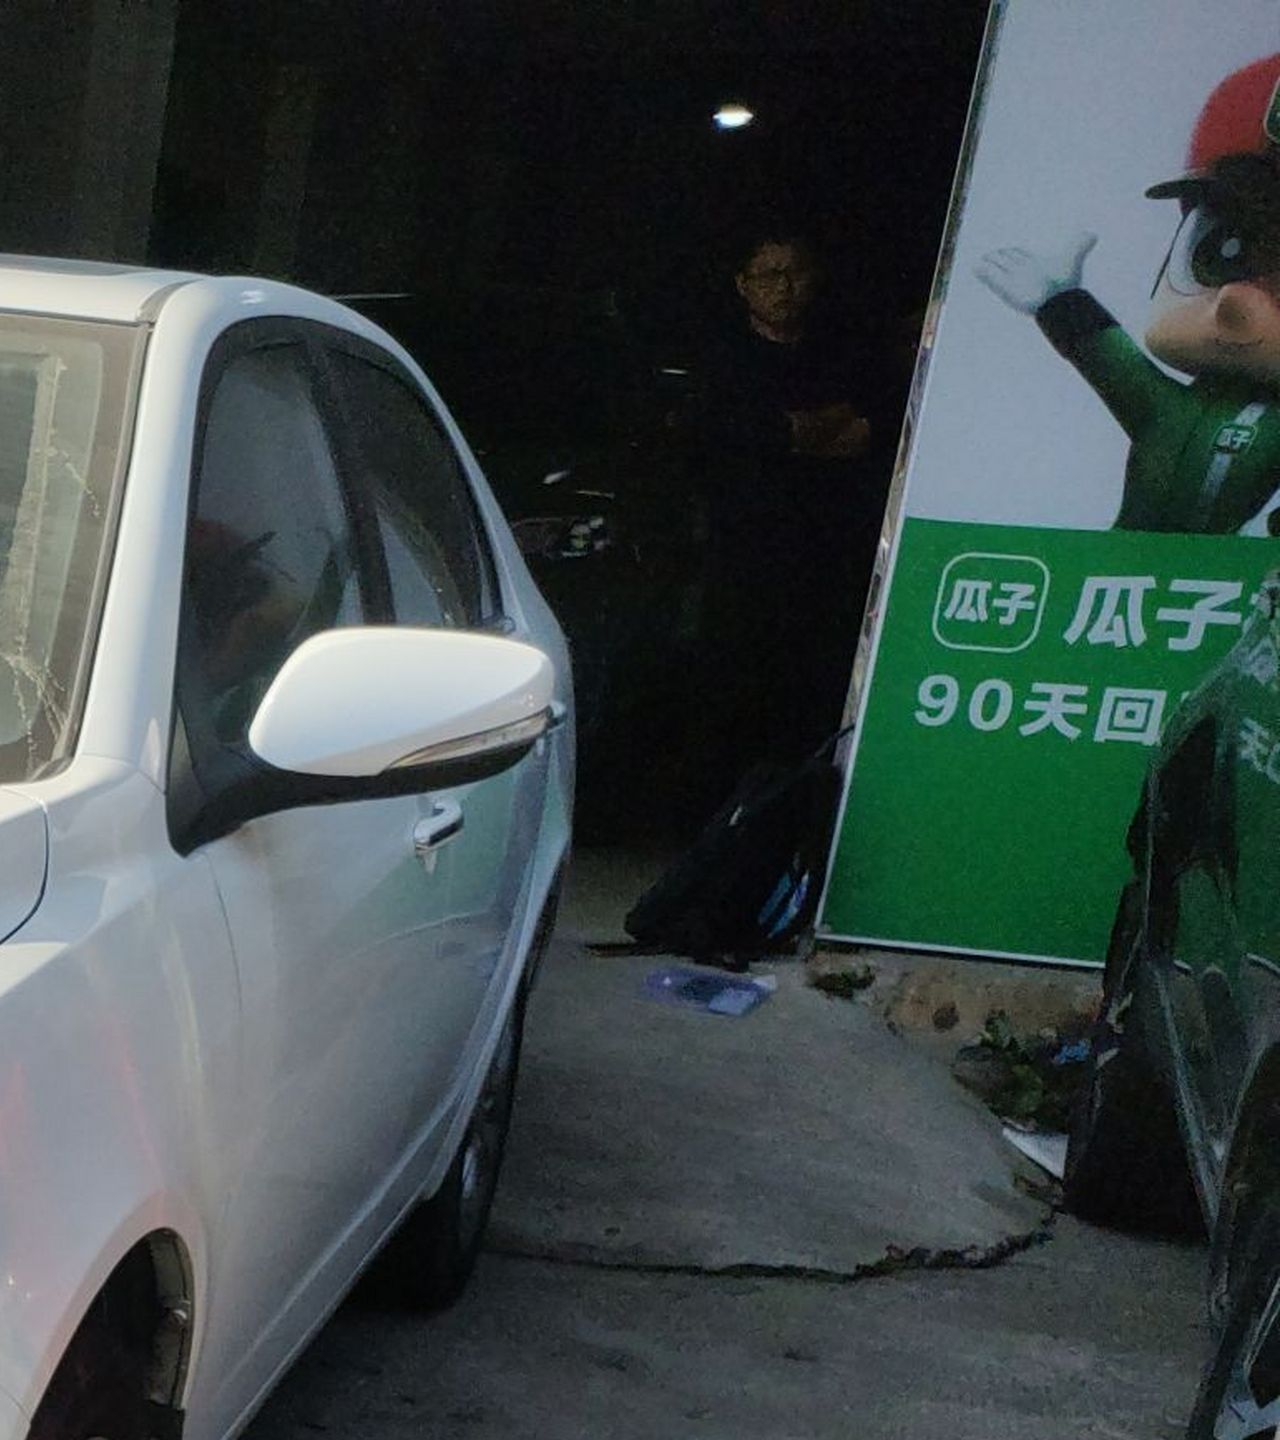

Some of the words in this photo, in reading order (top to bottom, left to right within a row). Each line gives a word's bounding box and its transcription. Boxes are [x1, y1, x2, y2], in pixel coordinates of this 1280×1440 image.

[944, 579, 1036, 626] 瓜子
[1064, 575, 1272, 651] 瓜子
[913, 674, 1190, 747] 90天回
